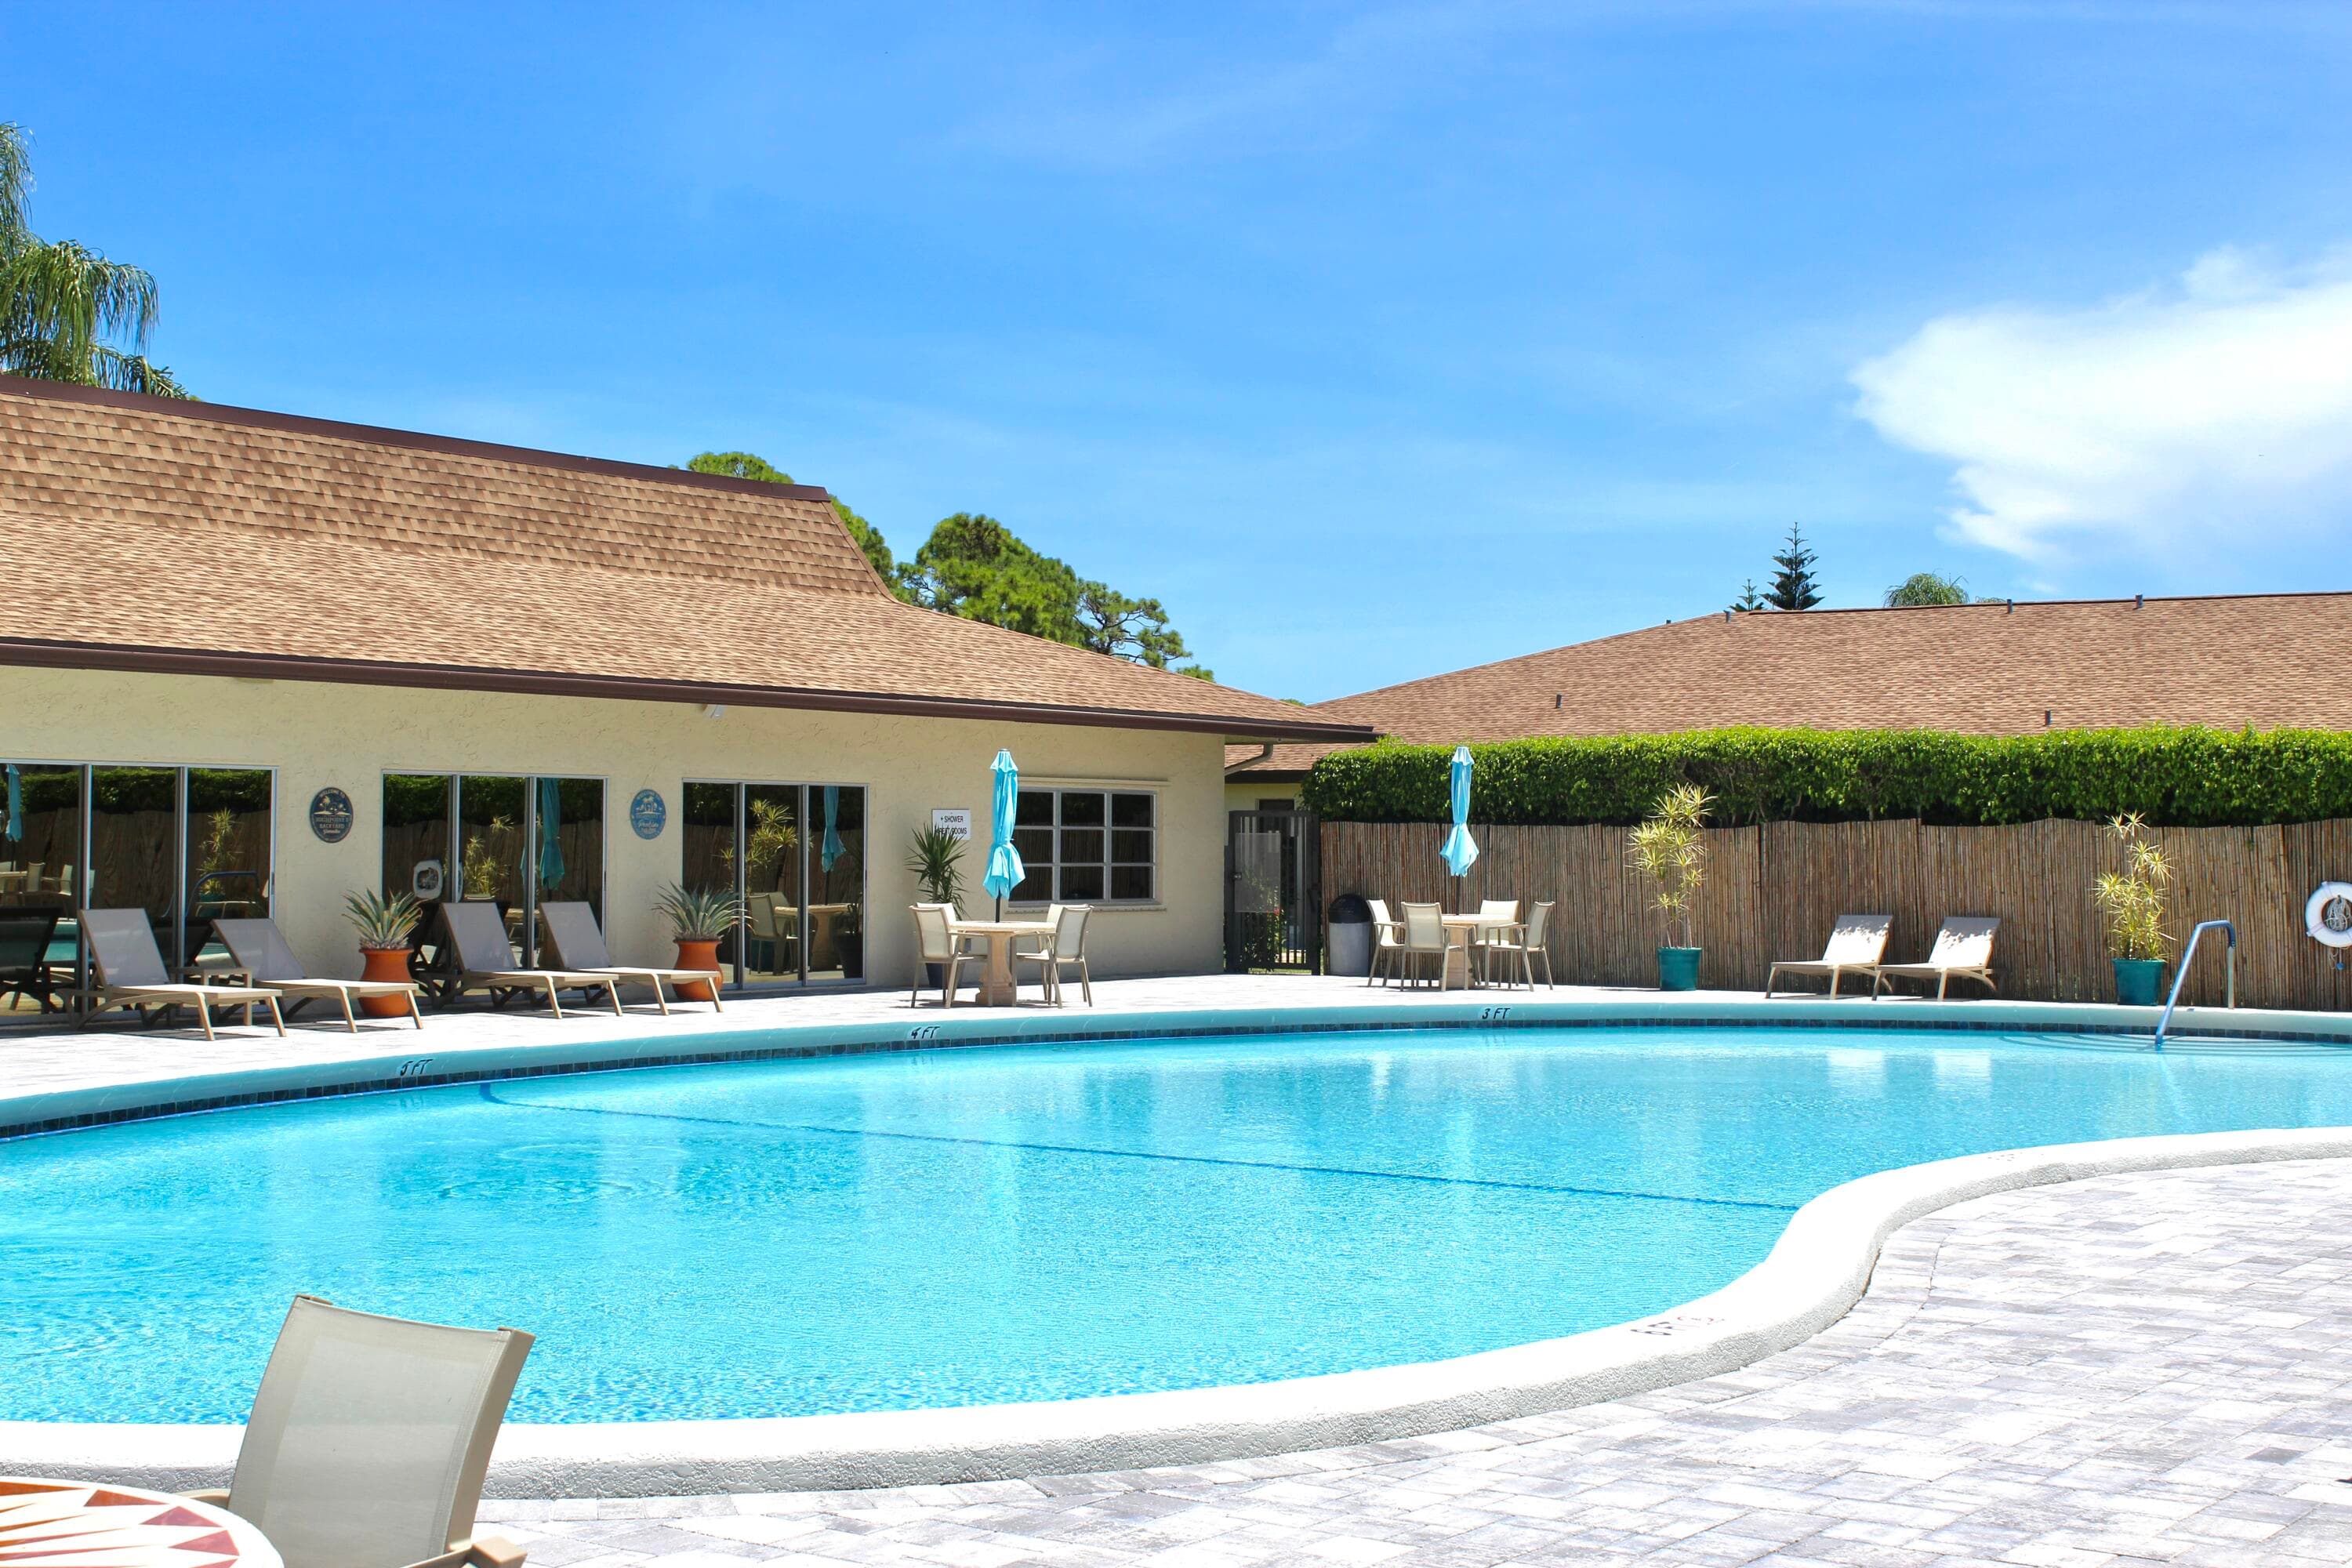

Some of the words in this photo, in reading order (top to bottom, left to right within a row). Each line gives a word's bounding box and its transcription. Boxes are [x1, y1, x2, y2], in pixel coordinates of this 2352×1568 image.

[1482, 1008, 1490, 1019] 3
[1493, 1007, 1511, 1019] FT
[911, 1027, 922, 1040] 4
[921, 1025, 941, 1039] FT
[411, 1058, 433, 1076] FT
